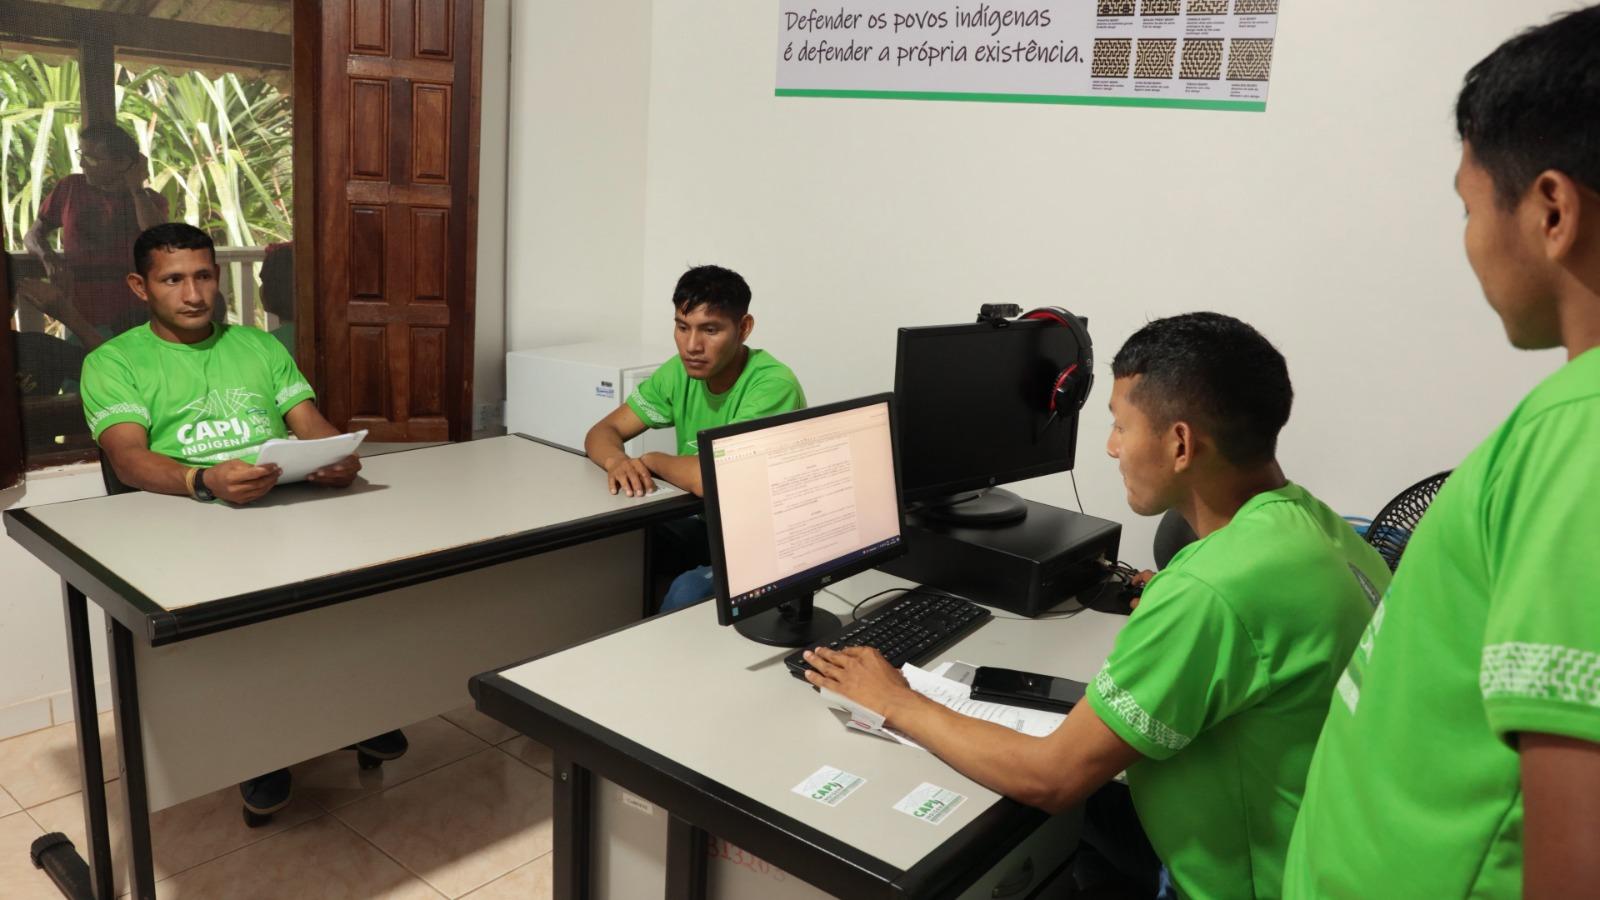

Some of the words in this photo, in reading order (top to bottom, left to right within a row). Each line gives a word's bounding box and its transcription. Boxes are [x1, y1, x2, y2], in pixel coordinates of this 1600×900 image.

[785, 7, 862, 33] Defender
[868, 12, 888, 30] os
[893, 10, 949, 34] povos
[955, 3, 1052, 37] indígenas
[783, 41, 793, 62] é
[798, 39, 873, 64] defender
[878, 46, 890, 62] a
[897, 40, 968, 67] própria
[974, 39, 1085, 63] existência.
